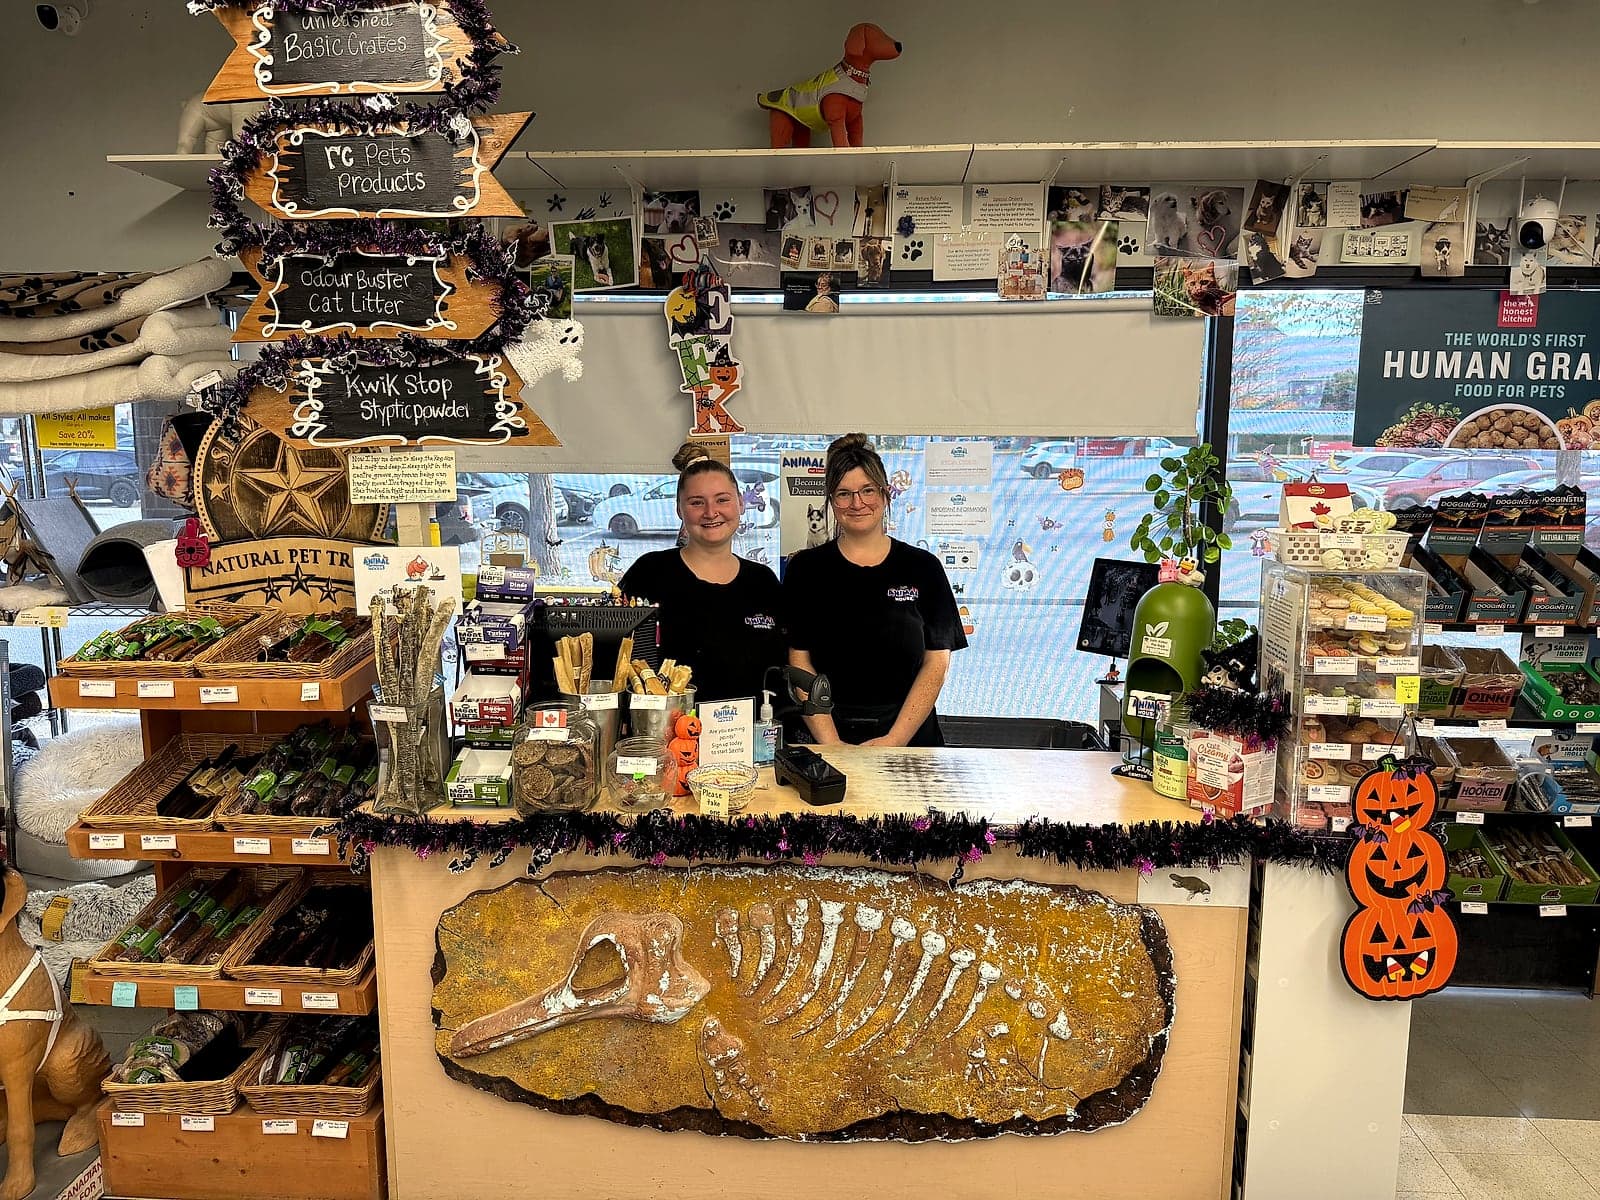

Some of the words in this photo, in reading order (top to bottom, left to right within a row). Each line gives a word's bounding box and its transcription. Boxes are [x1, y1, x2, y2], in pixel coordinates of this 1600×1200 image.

[302, 13, 393, 30] unleashed
[284, 33, 343, 62] Basic
[347, 32, 407, 56] Crates
[365, 141, 411, 166] Pets
[301, 269, 353, 288] Odour
[357, 269, 413, 291] Buster
[309, 293, 344, 313] Cat
[351, 291, 404, 316] Litter
[1503, 307, 1533, 315] honest
[1502, 315, 1533, 323] kitchen
[1445, 333, 1472, 346] THE
[1477, 333, 1541, 347] WORLD'S
[1545, 334, 1587, 348] FIRST
[1383, 350, 1511, 379] HUMAN
[1526, 351, 1600, 381] GRA
[404, 372, 453, 400] Stop
[1455, 384, 1493, 397] FOOD
[1497, 384, 1525, 398] FOR
[1530, 385, 1565, 398] PETS
[58, 431, 75, 439] Save
[77, 430, 95, 439] 20%
[782, 457, 825, 468] ANIMAL
[794, 478, 826, 486] Because
[791, 487, 825, 495] Deserves
[1440, 501, 1489, 509] DOGGINSTIX
[1540, 534, 1565, 542] NATURAL
[1566, 534, 1580, 542] TRIPE
[201, 549, 286, 578] NATURAL
[289, 547, 321, 565] PET
[326, 550, 353, 568] TR
[713, 710, 738, 718] ANIMAL
[1197, 744, 1229, 760] Creamy
[702, 788, 723, 799] Please
[1461, 786, 1504, 797] HOOKED!
[60, 1162, 103, 1200] CANADIAN
[79, 1181, 97, 1200] FOR
